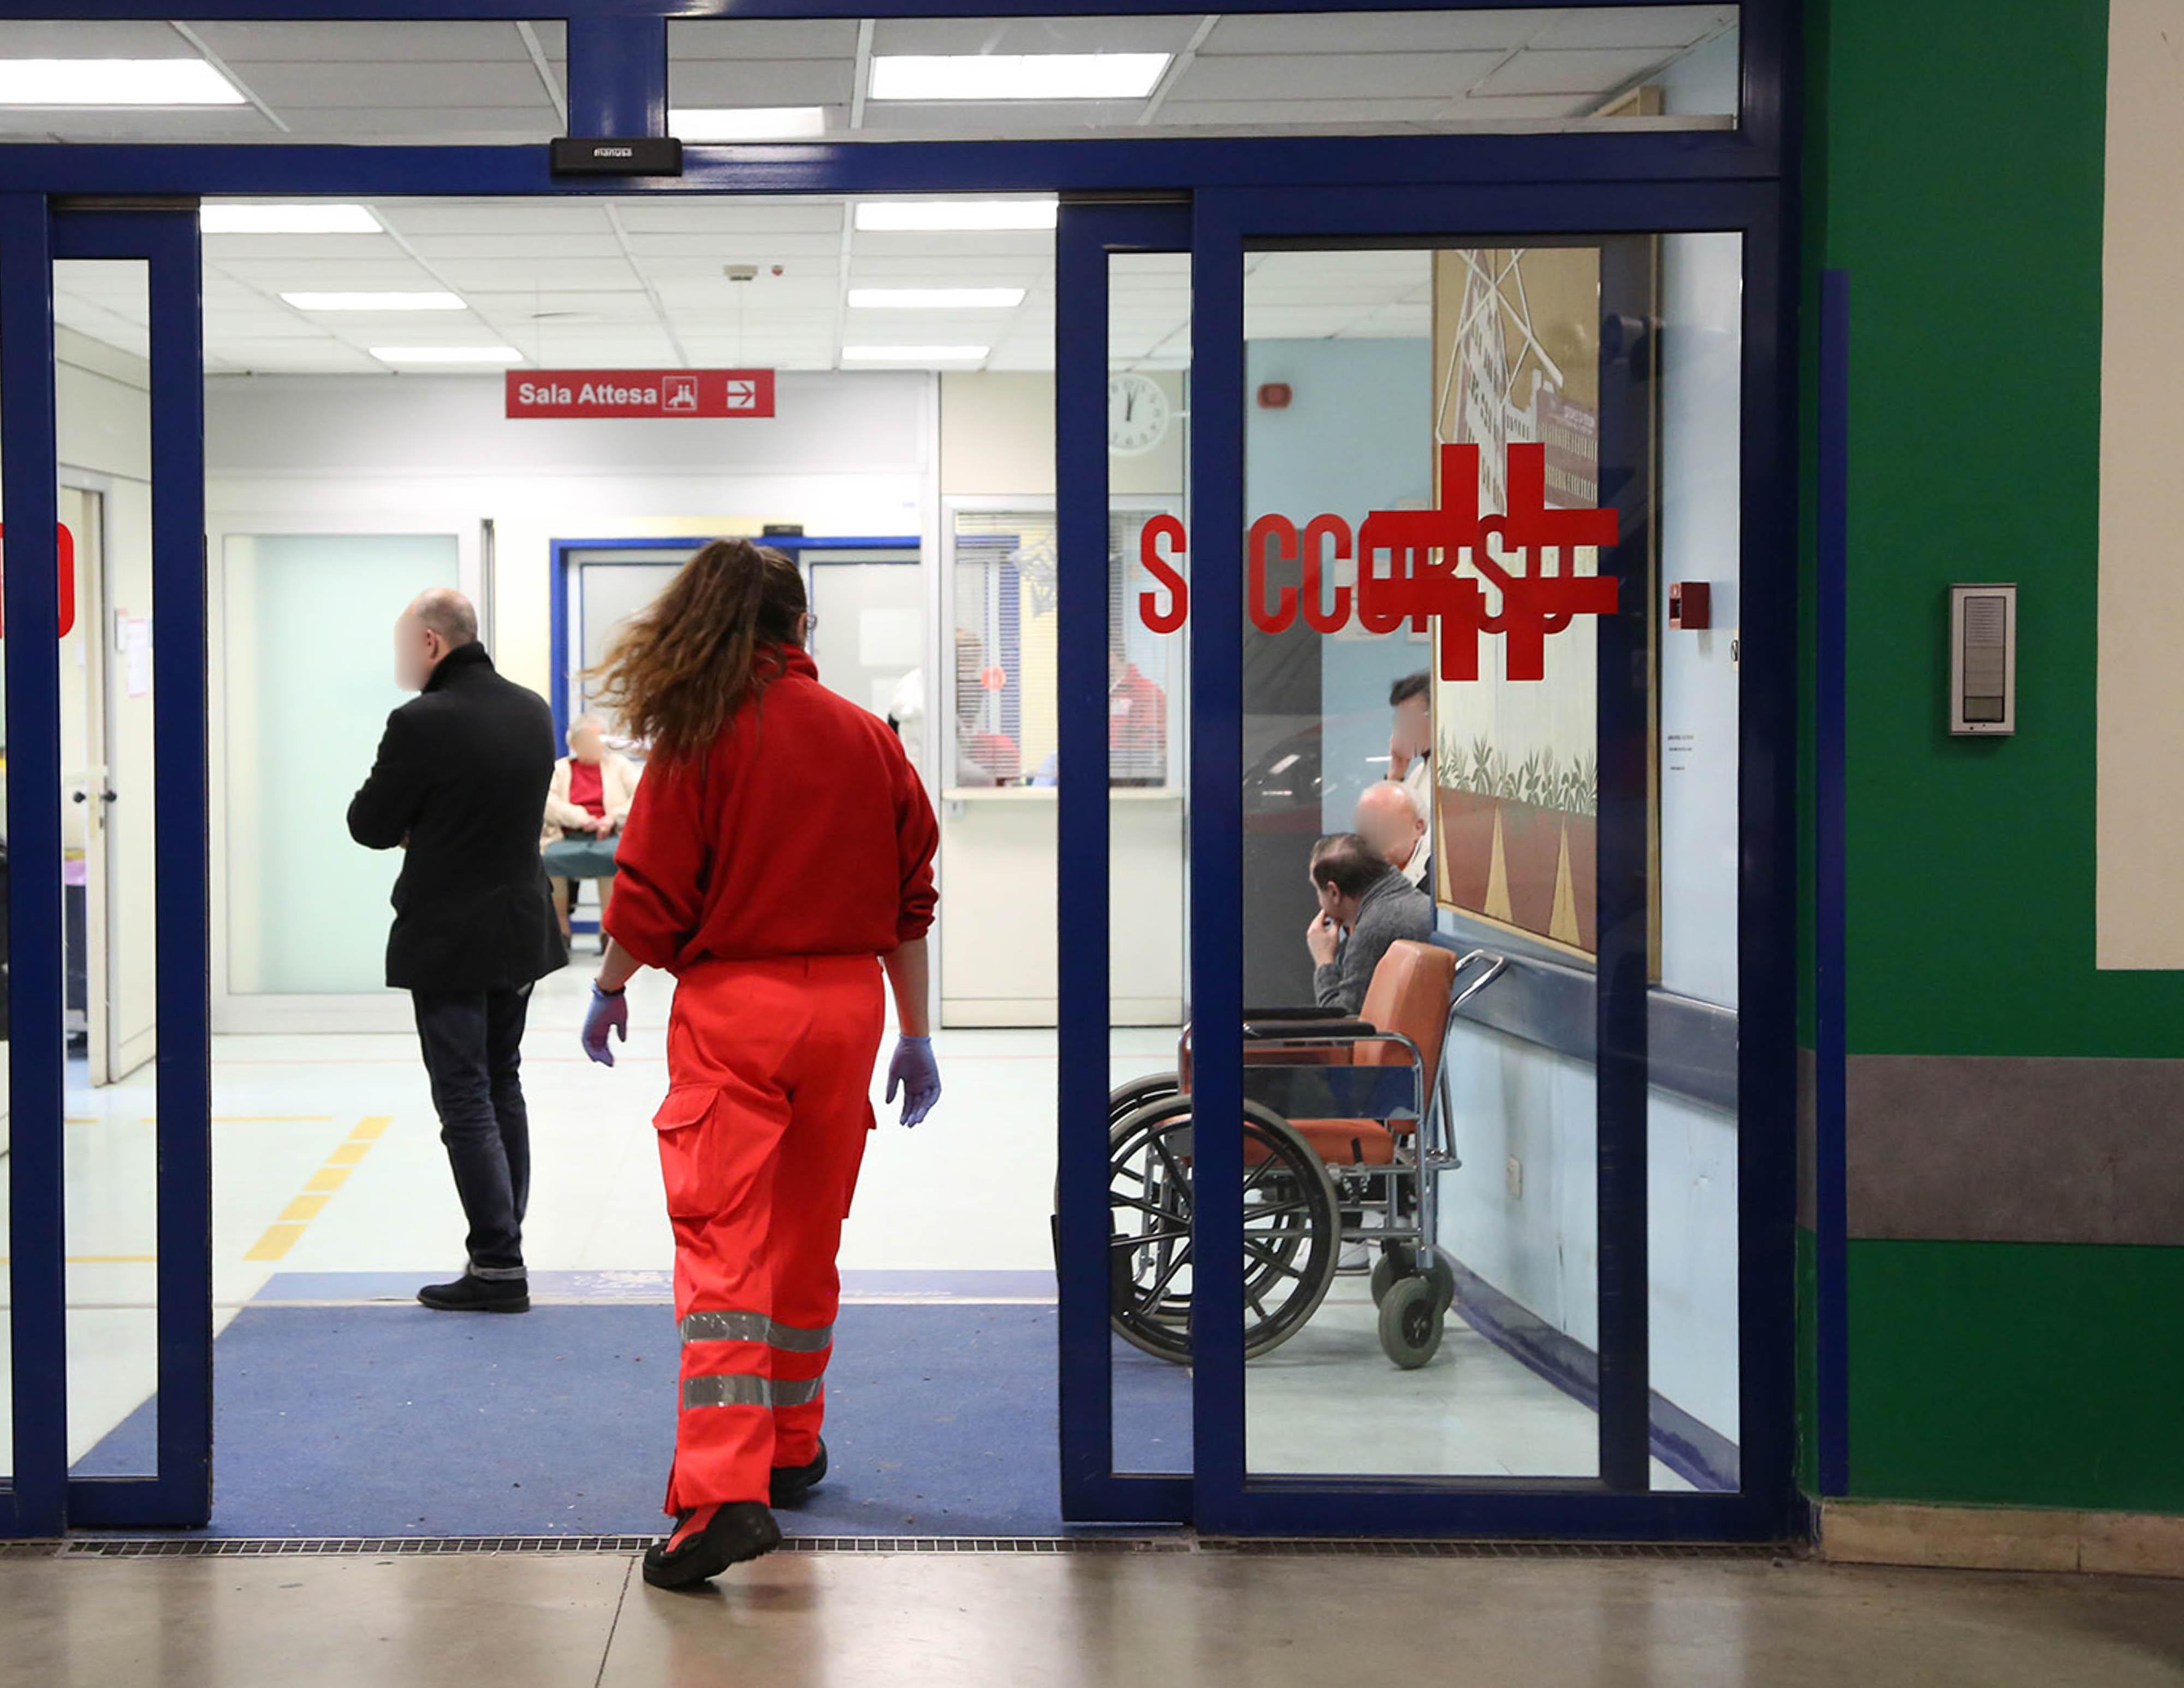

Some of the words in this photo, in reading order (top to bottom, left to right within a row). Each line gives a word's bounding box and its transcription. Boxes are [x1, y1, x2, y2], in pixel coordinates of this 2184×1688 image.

[519, 383, 572, 404] Sala
[578, 383, 657, 404] Attesa
[1139, 513, 1574, 634] SCCOS
